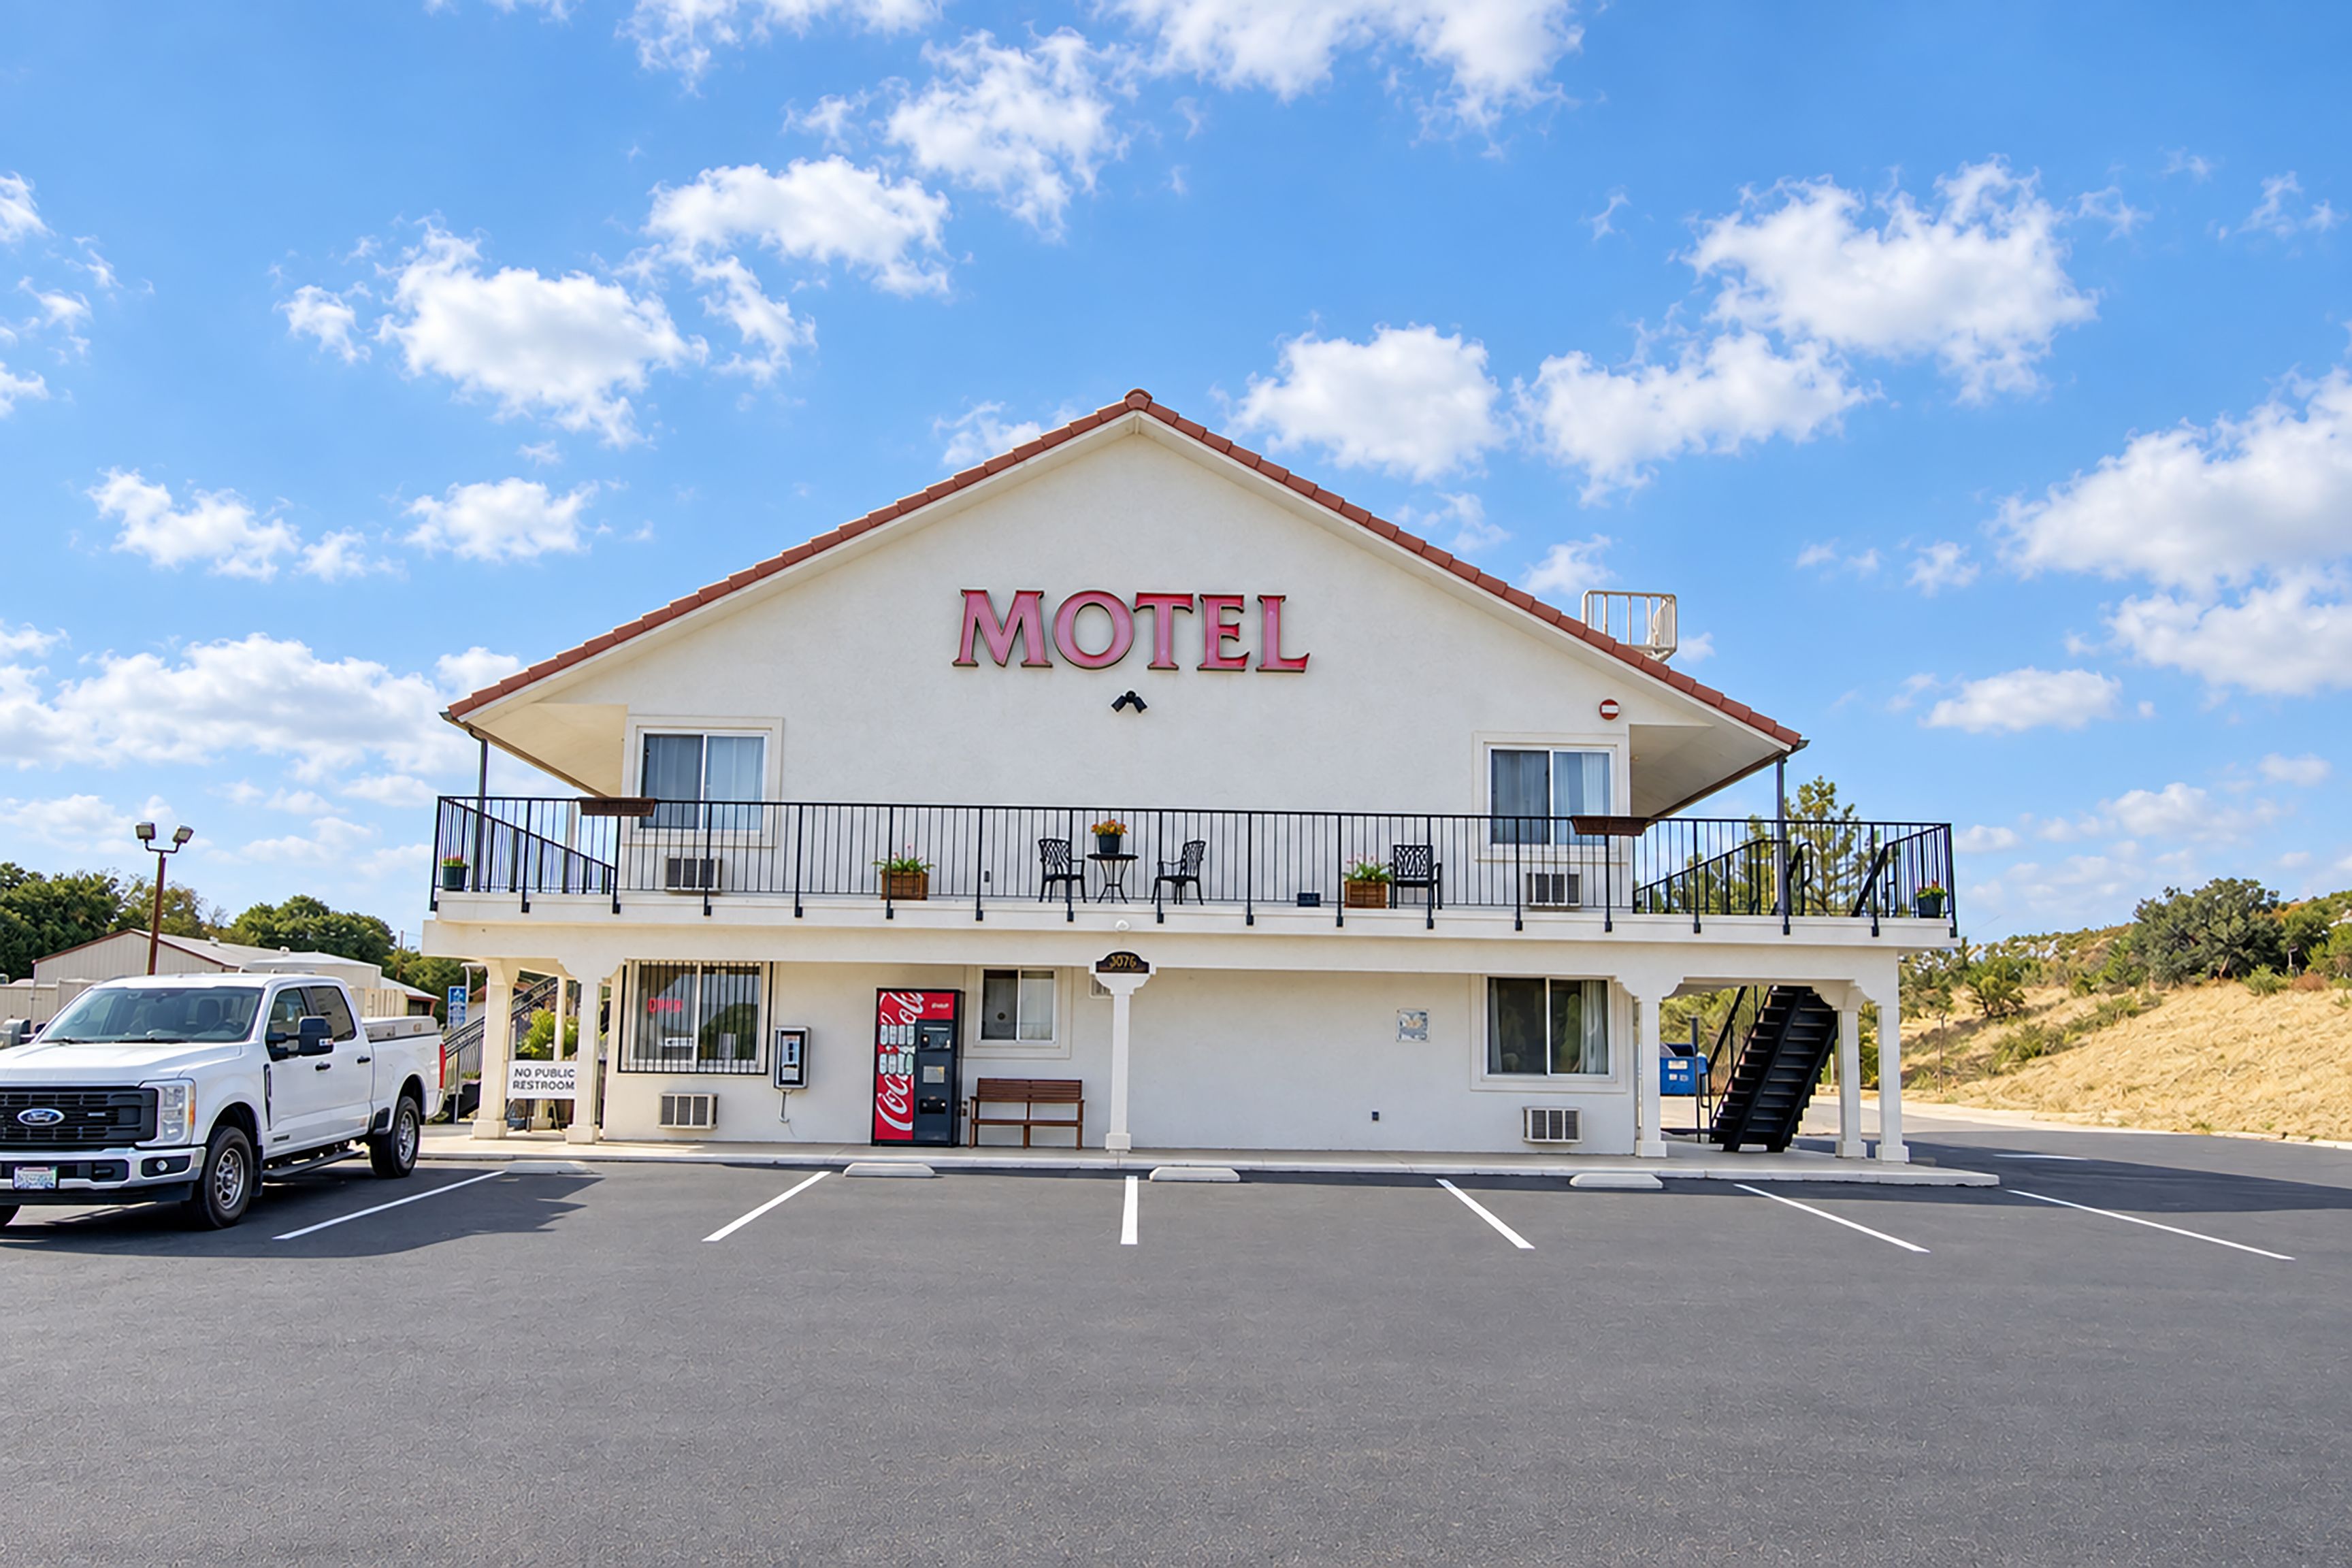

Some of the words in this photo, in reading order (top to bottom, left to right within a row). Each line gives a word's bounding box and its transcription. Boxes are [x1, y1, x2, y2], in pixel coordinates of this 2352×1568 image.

[952, 589, 1310, 672] MOTEL
[514, 1068, 532, 1077] NO
[535, 1068, 575, 1078] PUBLIC
[512, 1081, 575, 1090] RESTROOM
